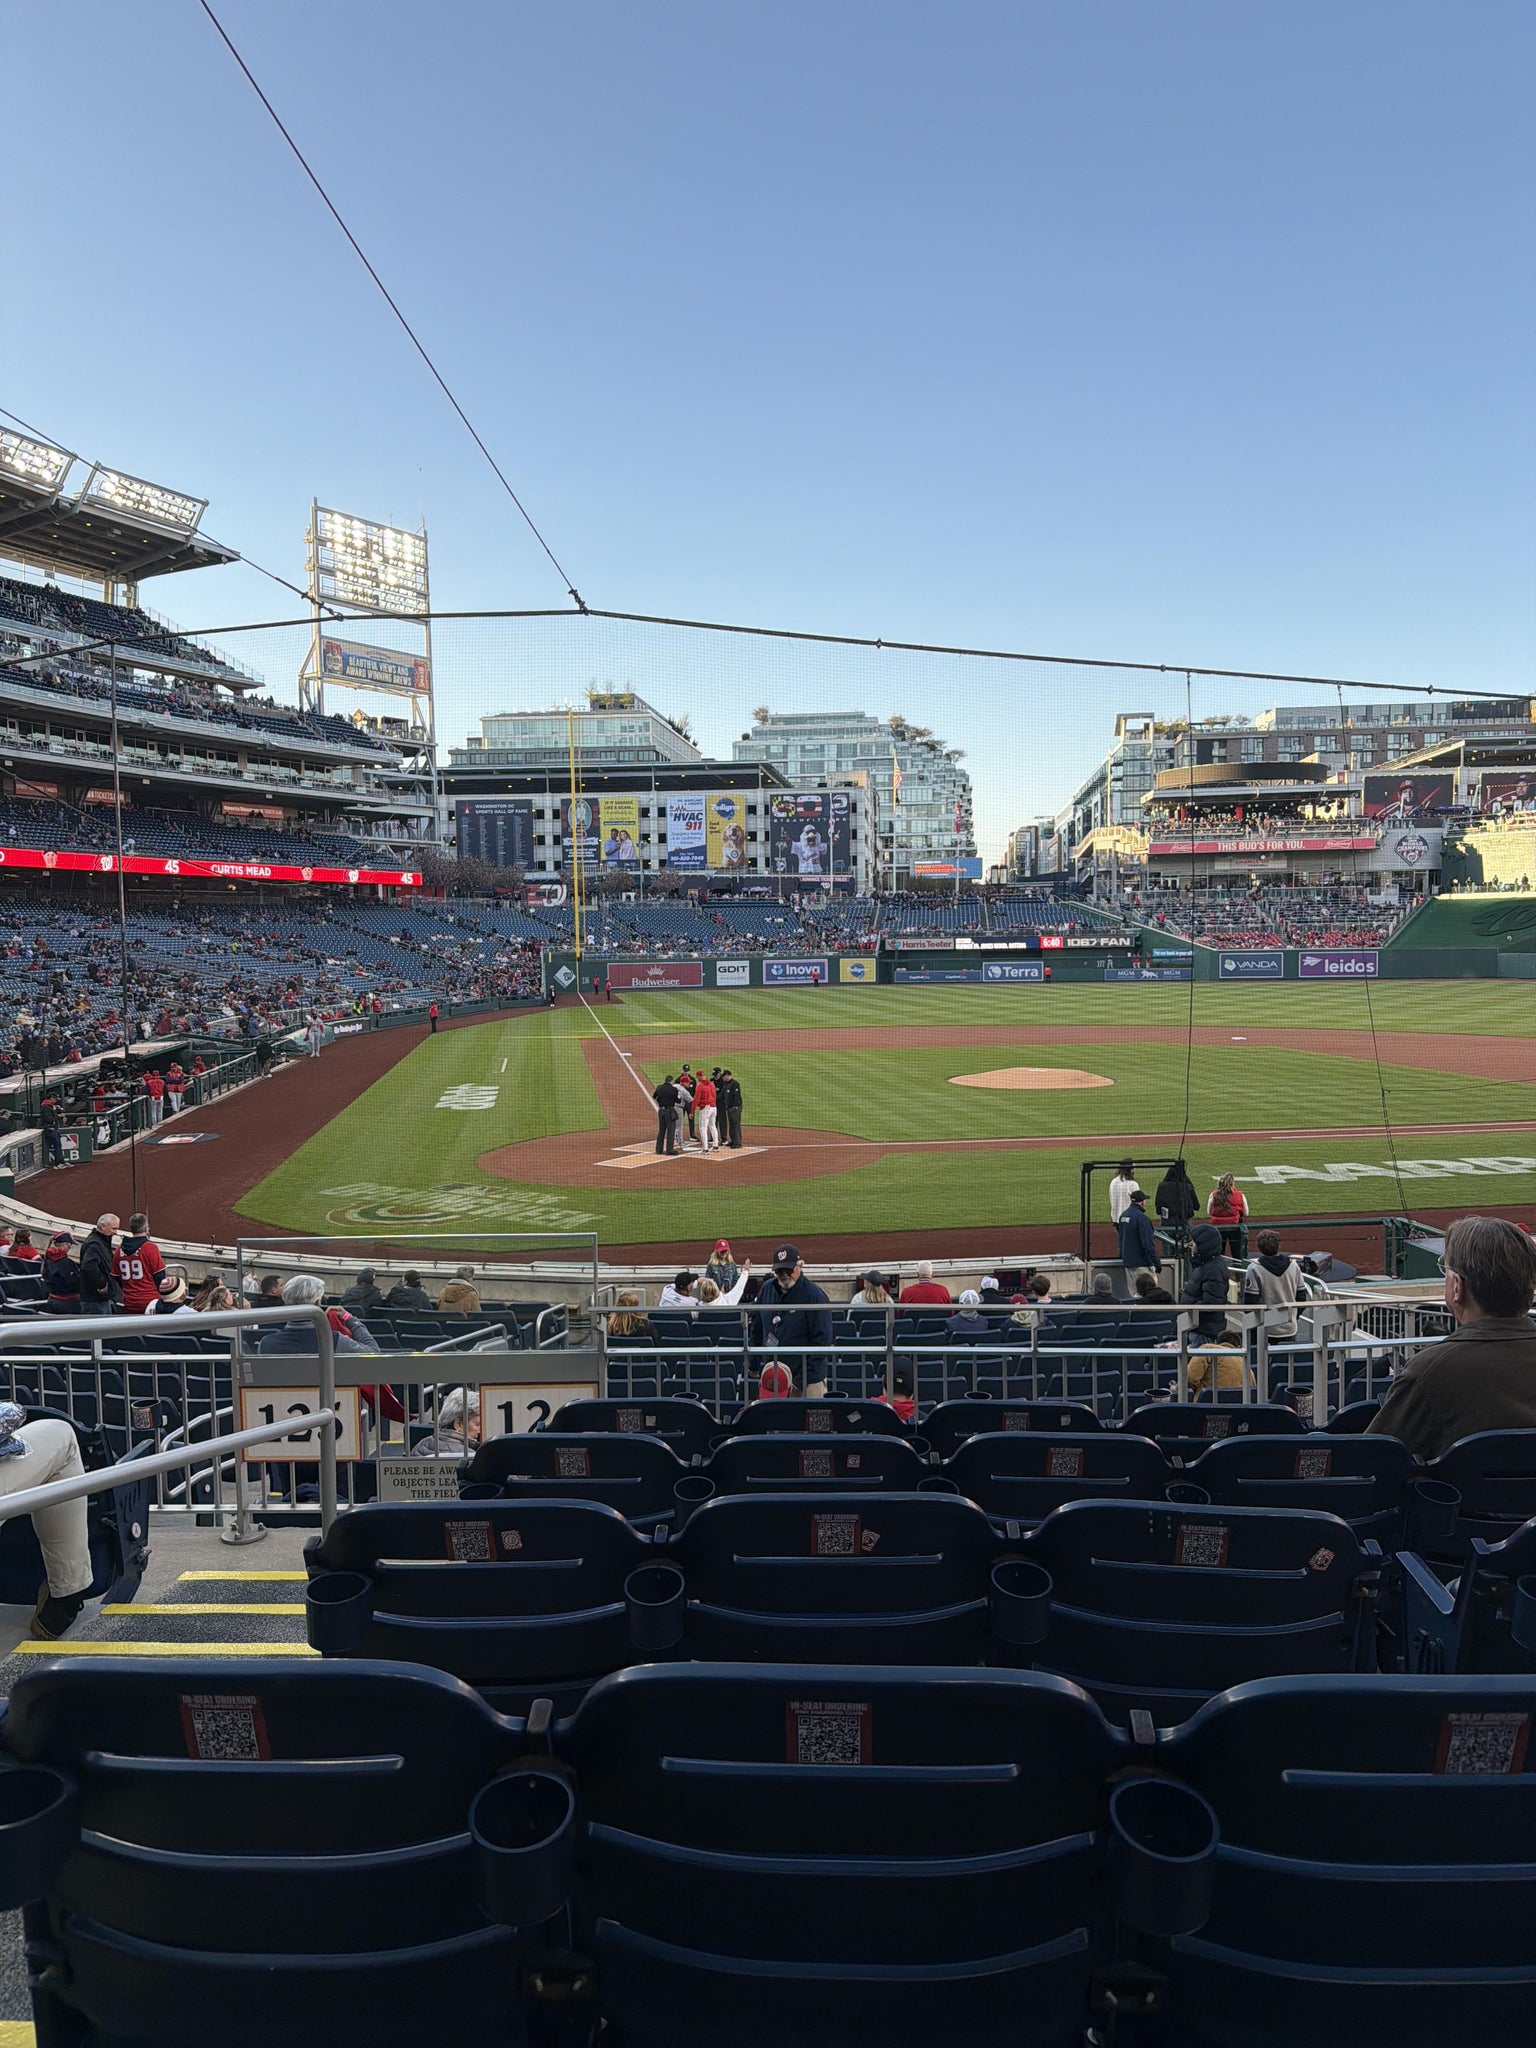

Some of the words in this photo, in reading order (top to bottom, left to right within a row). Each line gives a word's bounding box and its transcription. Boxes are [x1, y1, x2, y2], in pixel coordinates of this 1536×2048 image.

[349, 656, 378, 670] BEAUTIFUL
[380, 662, 396, 674] VIEWS
[346, 666, 366, 678] AWARD
[367, 670, 393, 683] WINNING
[393, 674, 412, 686] BREWS
[673, 812, 704, 821] HVAC
[685, 821, 702, 830] 911
[1217, 842, 1237, 850] THIS
[1239, 842, 1264, 850] BUD'S
[1267, 841, 1284, 850] FOR
[1286, 840, 1305, 849] YOU.
[165, 859, 180, 873] 45
[211, 864, 243, 875] CURTIS
[246, 866, 271, 876] MEAD
[401, 873, 413, 884] 45
[1043, 938, 1060, 947] 6:40
[1100, 938, 1130, 946] FAN
[786, 964, 820, 975] Inova
[1324, 959, 1375, 973] leidos
[1003, 966, 1038, 978] Terra
[632, 978, 680, 986] Budweiser
[119, 1260, 143, 1280] 99
[497, 1400, 551, 1433] 12
[384, 1467, 420, 1475] PLEASE
[423, 1466, 435, 1475] BE
[439, 1466, 458, 1475] AWA
[393, 1478, 435, 1488] OBJECTS
[411, 1490, 431, 1498] THE
